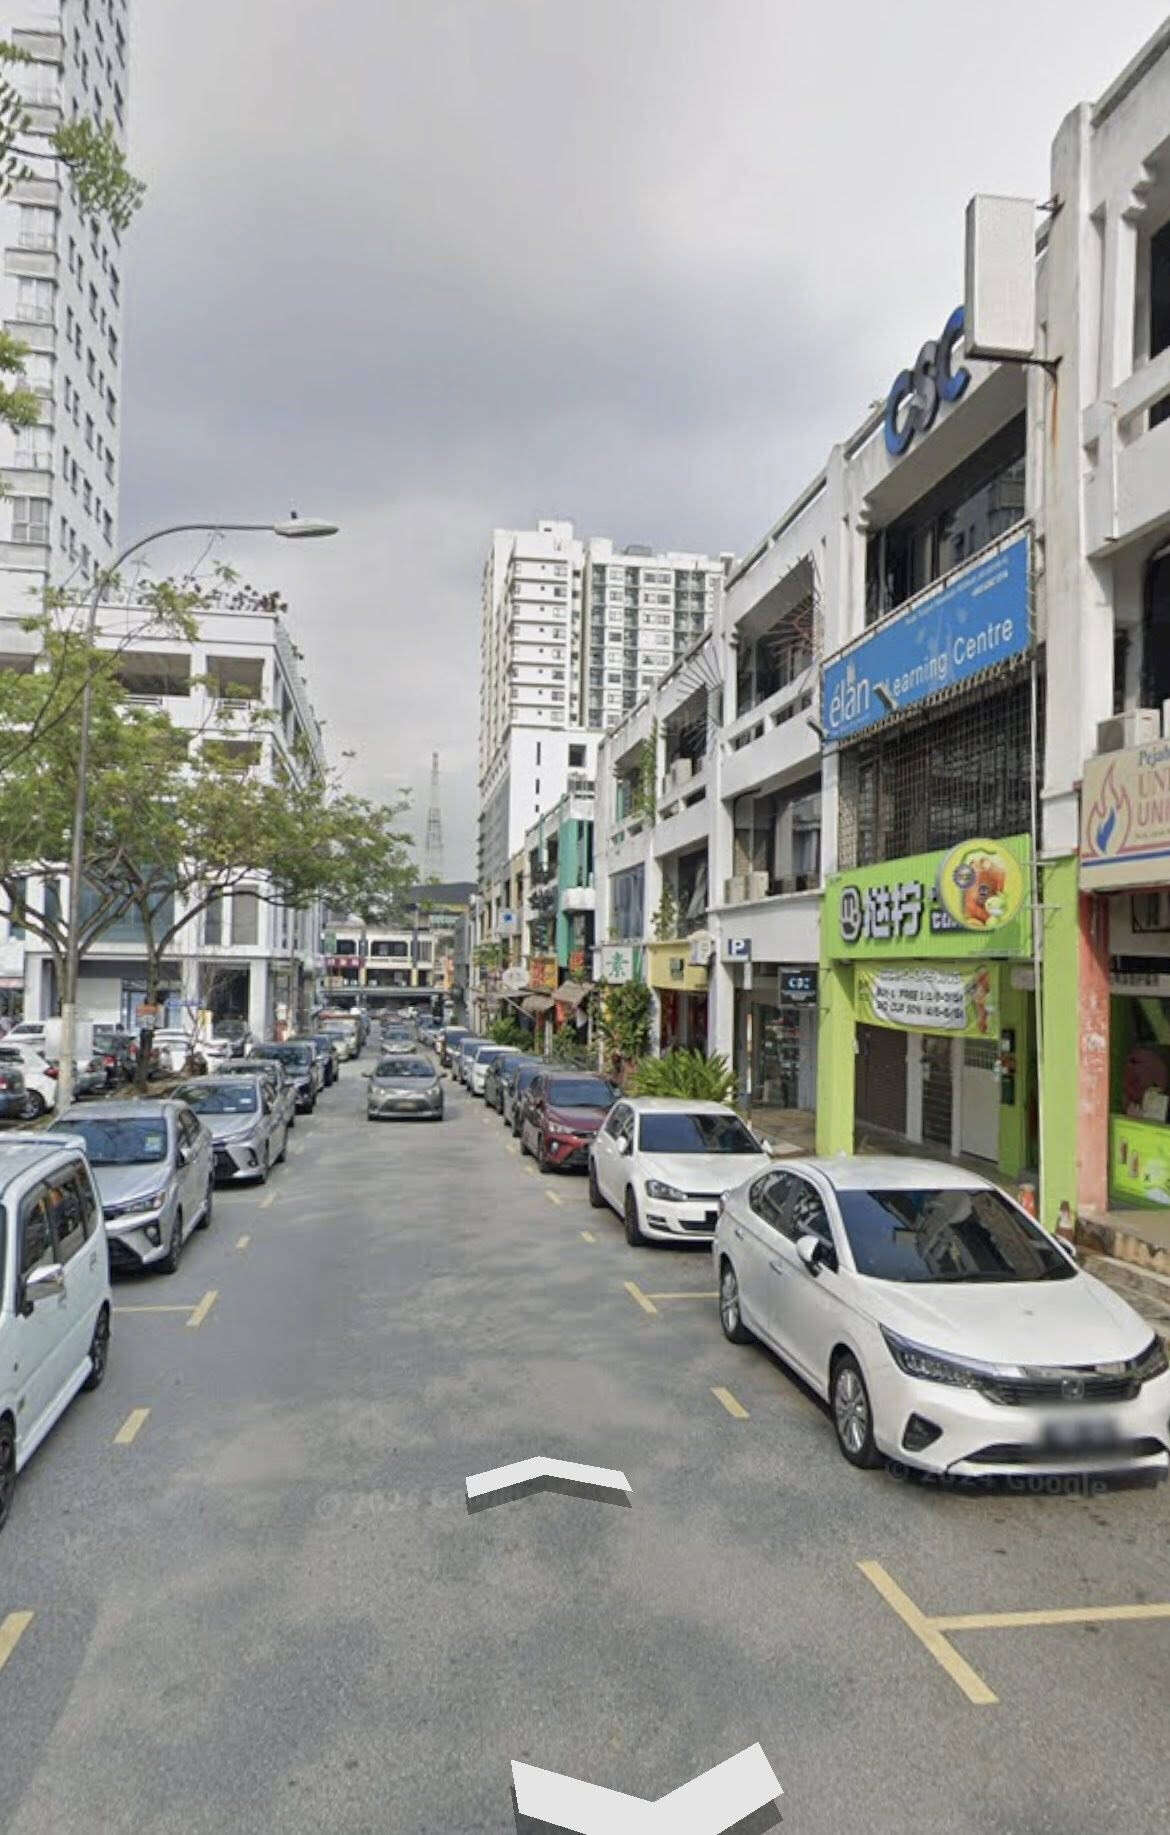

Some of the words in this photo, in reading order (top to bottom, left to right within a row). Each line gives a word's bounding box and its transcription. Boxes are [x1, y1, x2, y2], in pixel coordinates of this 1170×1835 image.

[884, 306, 972, 456] CSC
[953, 617, 1013, 666] Centre
[731, 939, 746, 955] P
